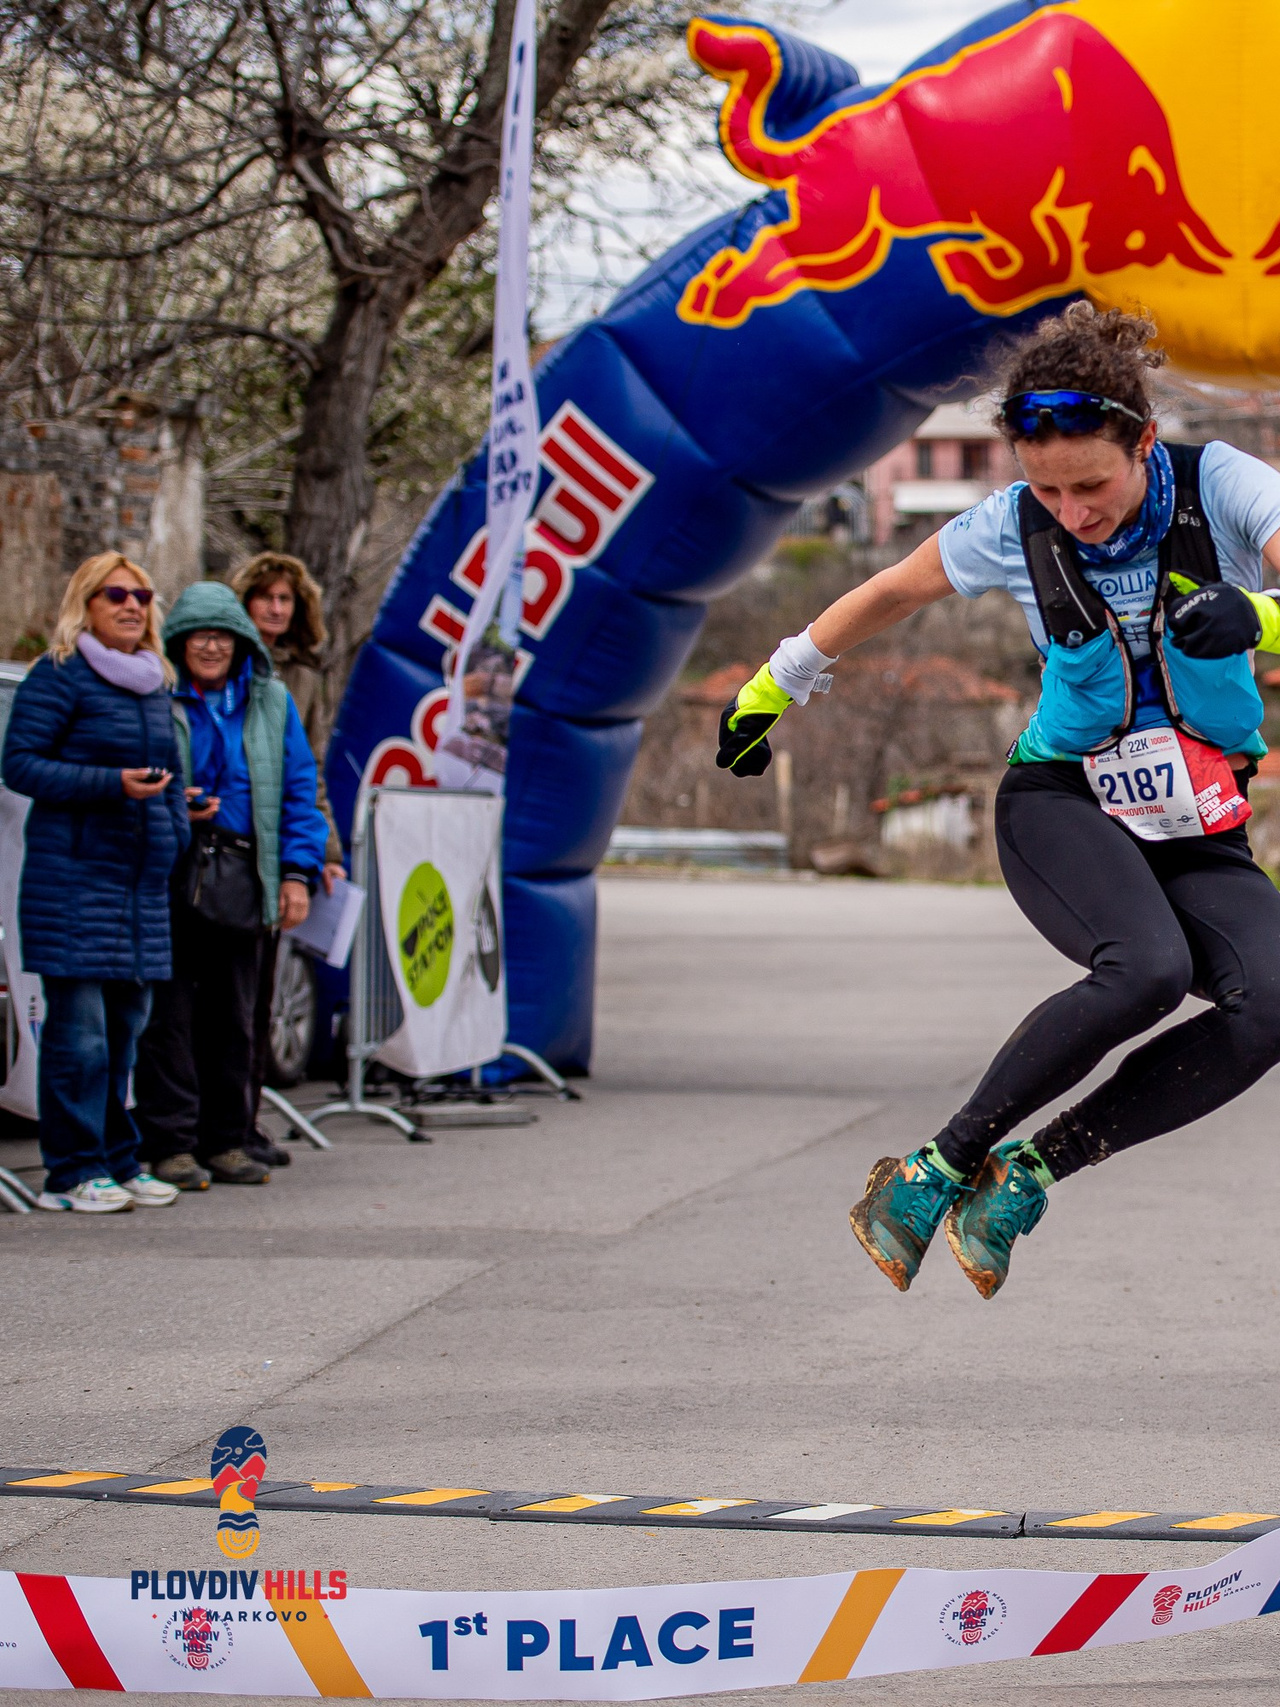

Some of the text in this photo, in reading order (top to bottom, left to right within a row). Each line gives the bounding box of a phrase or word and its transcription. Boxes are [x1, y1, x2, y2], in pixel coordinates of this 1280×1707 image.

[1127, 737, 1149, 754] 22K
[1098, 762, 1174, 805] 2187
[1195, 782, 1222, 808] EVERY
[1109, 804, 1166, 817] MARKOVO TRAIL
[1199, 797, 1222, 817] STEP
[1186, 1569, 1243, 1602] PLOVDIV
[1223, 1581, 1261, 1597] MARKOVO
[1183, 1591, 1221, 1613] HILLS
[952, 1607, 995, 1620] PLOVDIV
[959, 1618, 987, 1630] HILLS
[174, 1629, 220, 1641] PLOVDIV
[418, 1606, 755, 1672] 1st PLACE
[183, 1643, 213, 1653] HILLS
